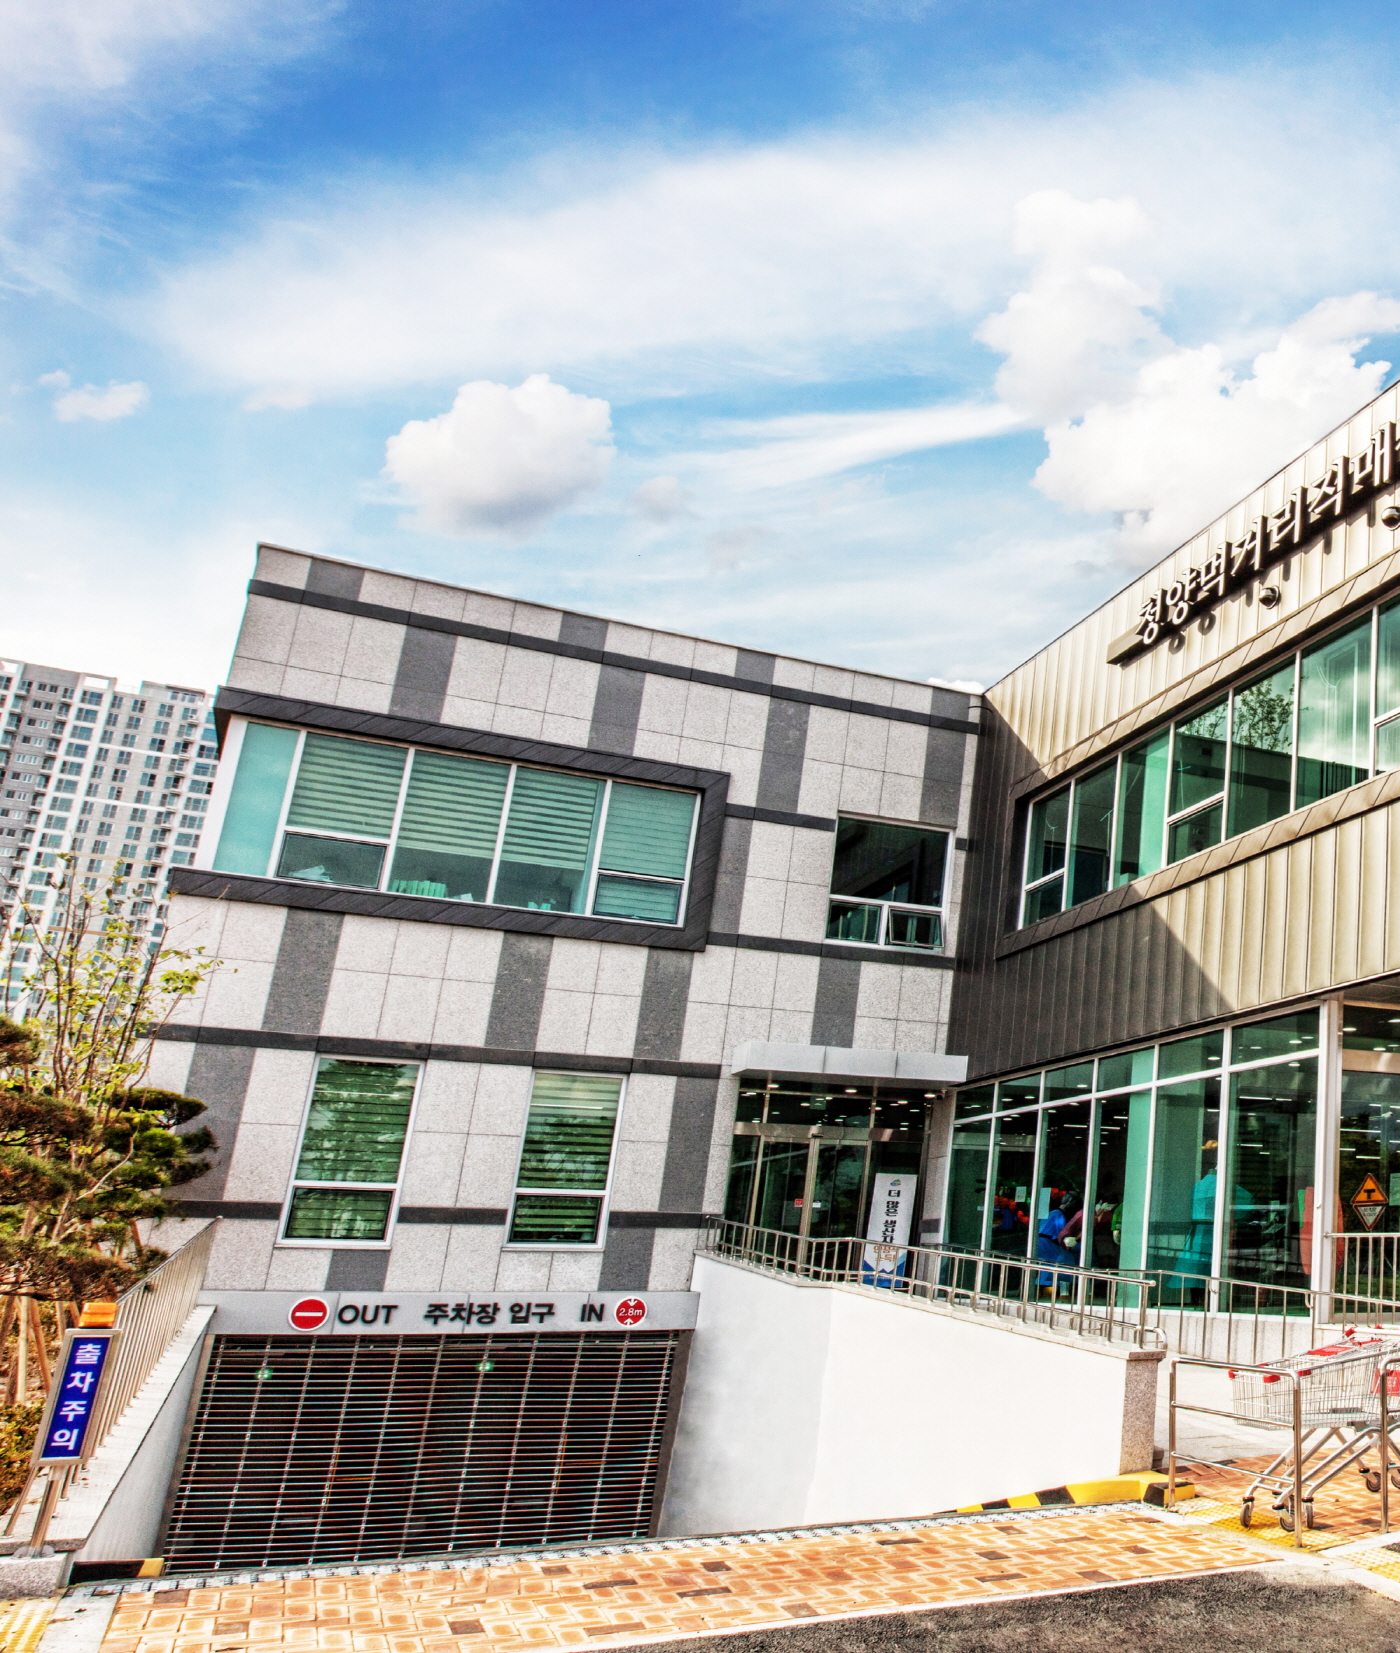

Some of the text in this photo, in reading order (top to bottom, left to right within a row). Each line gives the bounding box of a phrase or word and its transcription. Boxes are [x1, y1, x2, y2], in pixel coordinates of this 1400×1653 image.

[887, 1189, 901, 1198] 더
[884, 1200, 900, 1217] 많은
[337, 1302, 606, 1326] OUT 주차장 입구 IN
[618, 1307, 643, 1317] 2.8m
[50, 1343, 103, 1451] 출차주의
